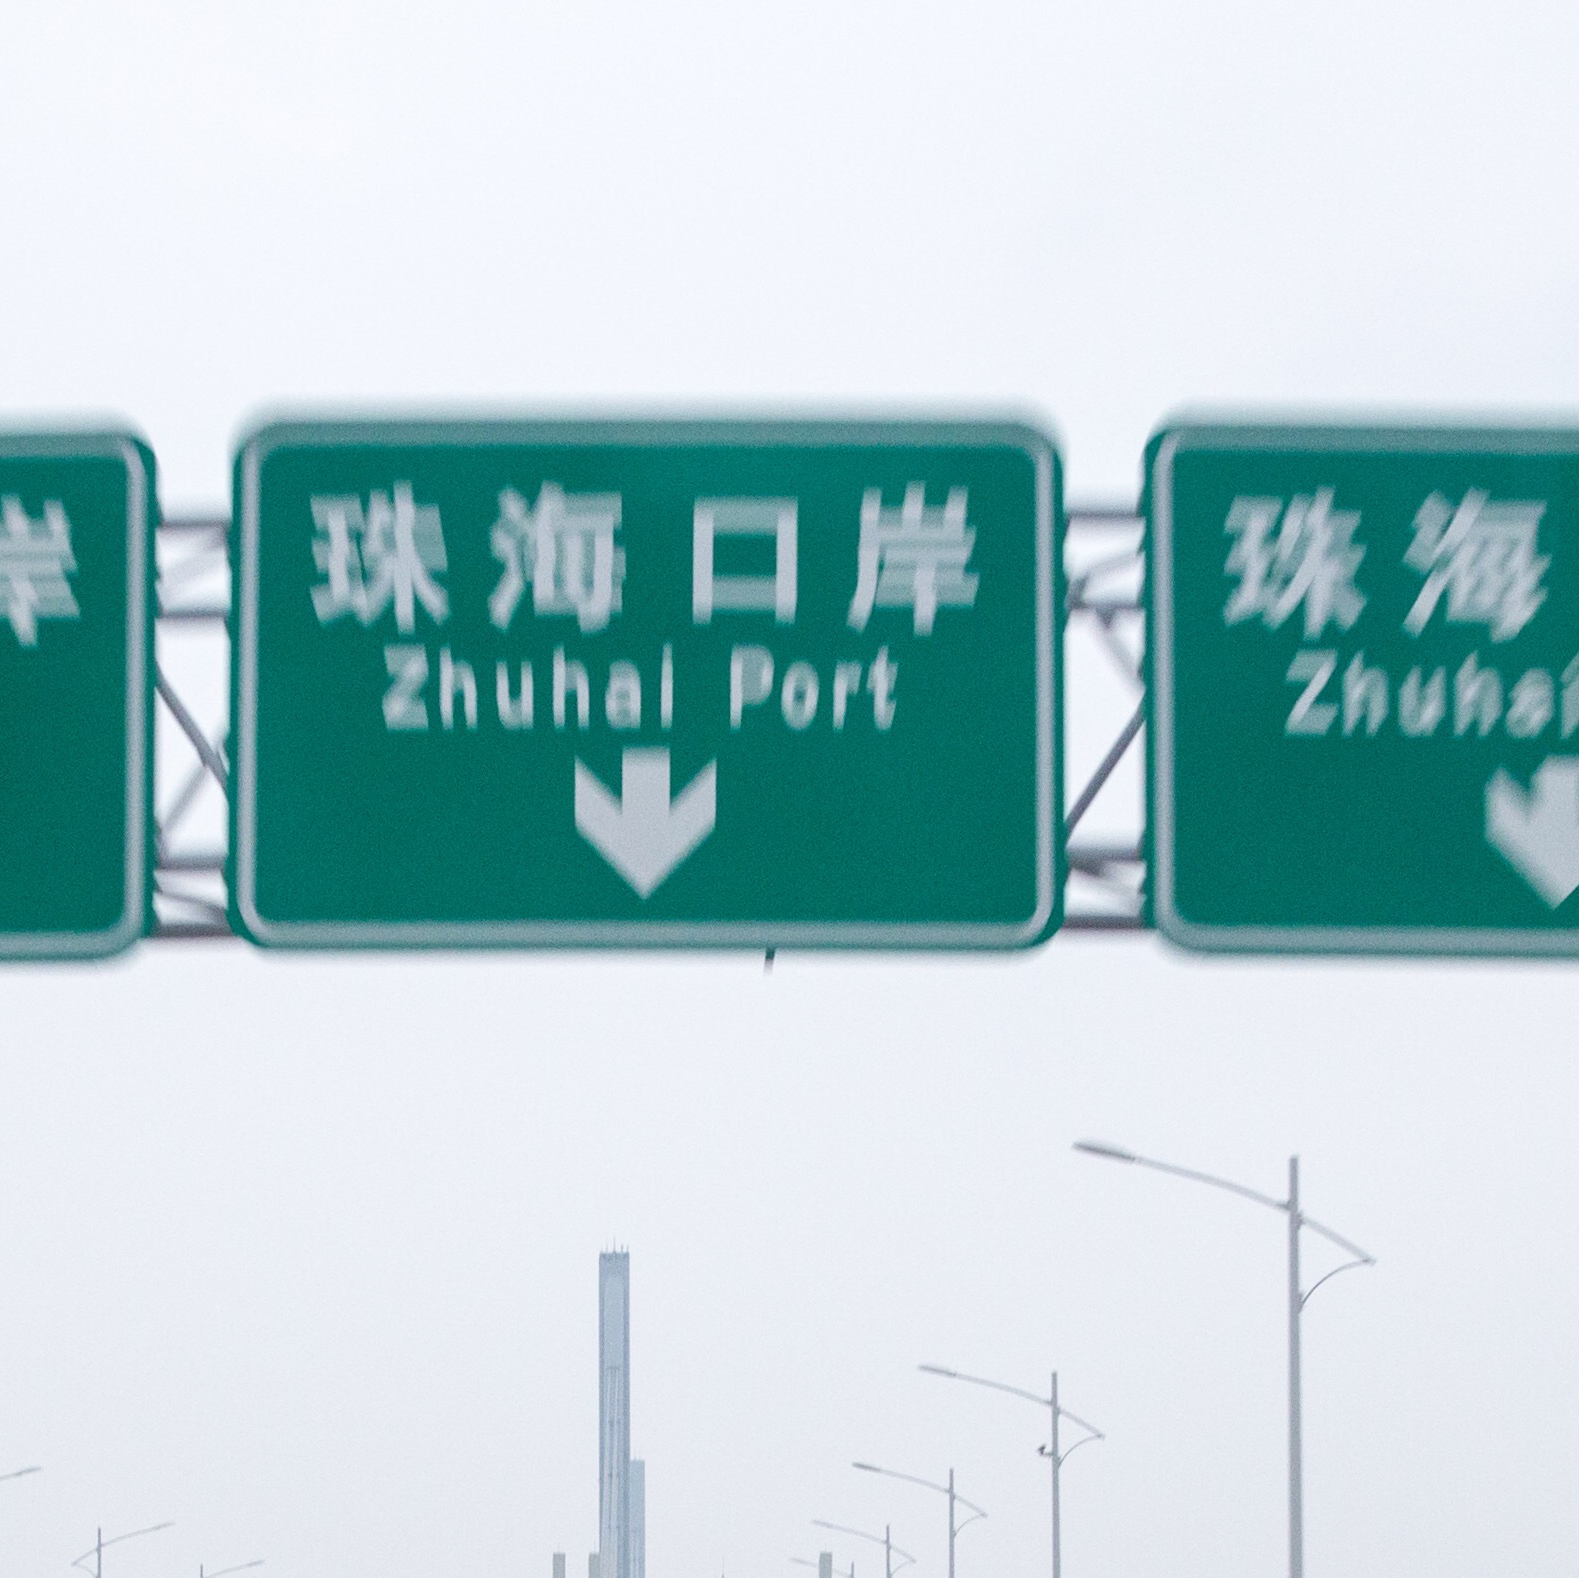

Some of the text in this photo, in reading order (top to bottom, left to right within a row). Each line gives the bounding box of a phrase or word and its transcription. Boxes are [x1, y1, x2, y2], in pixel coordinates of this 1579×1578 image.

[309, 480, 980, 635] 珠海口岸
[382, 643, 898, 731] Zhuhai Port
